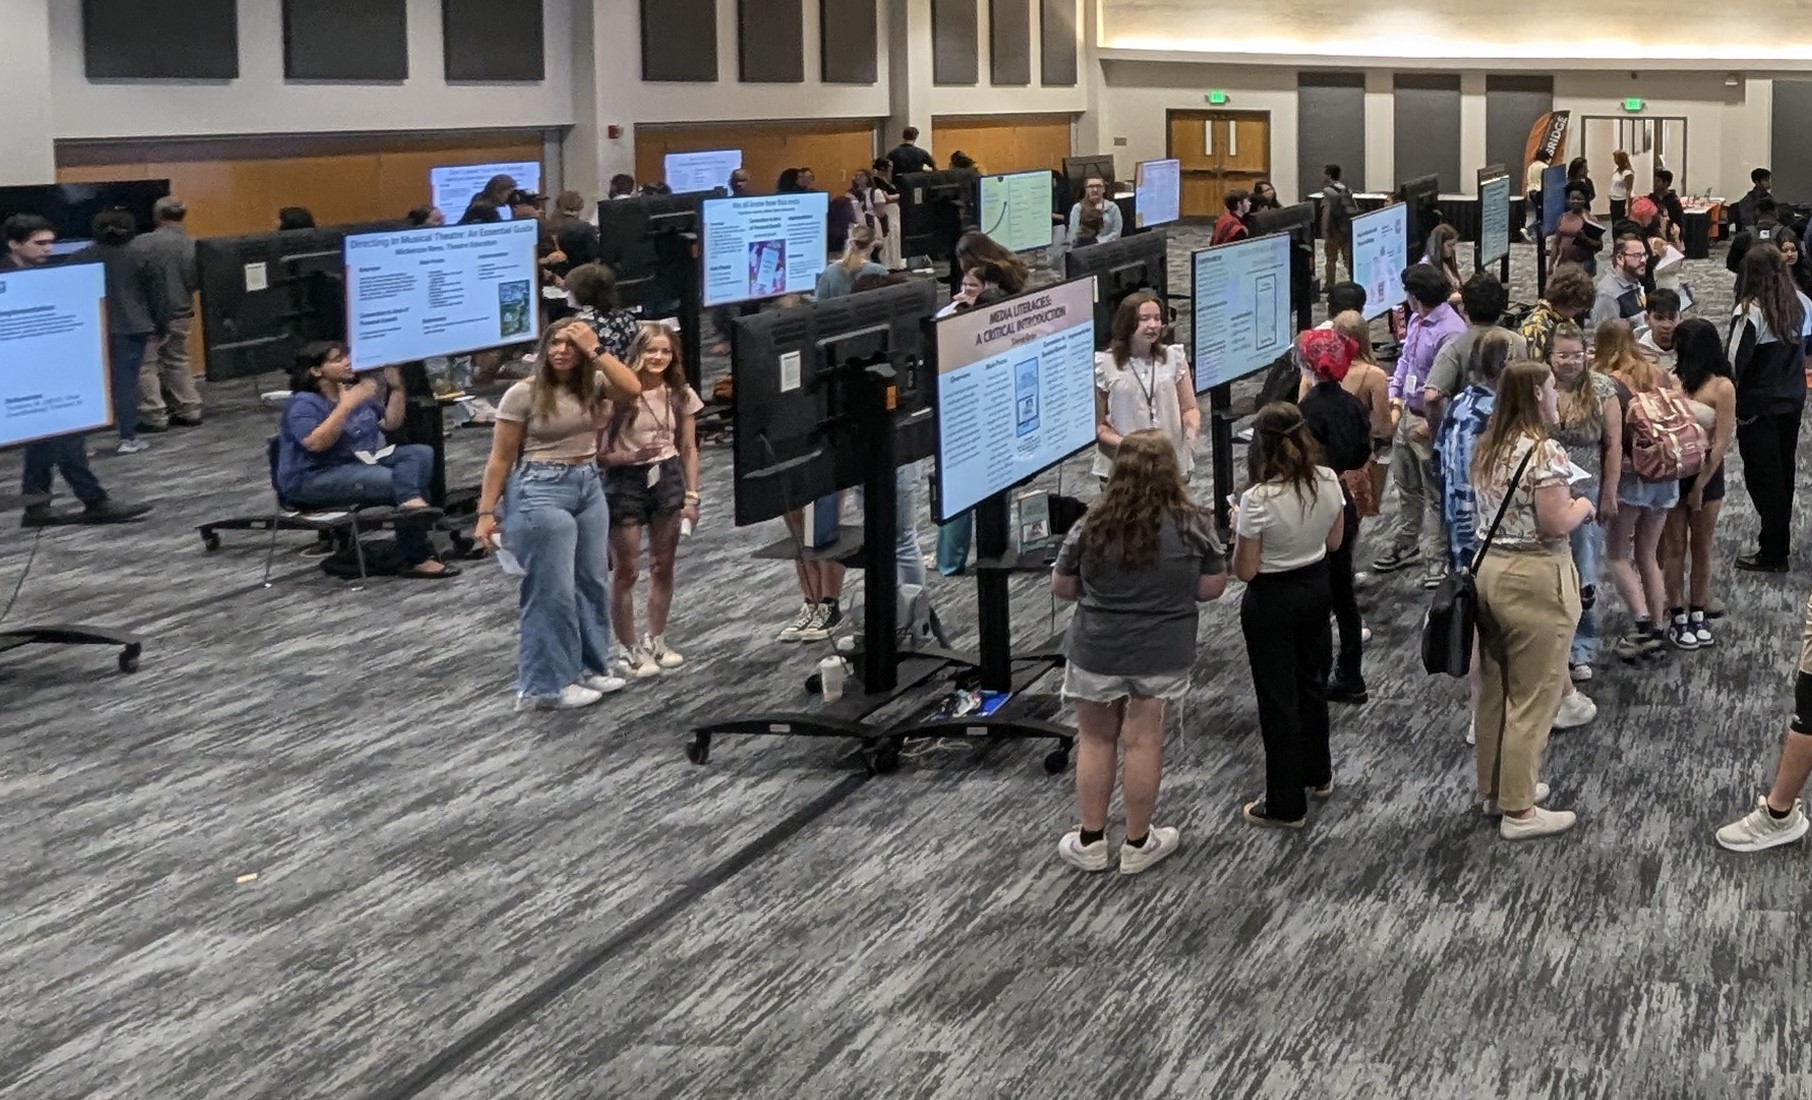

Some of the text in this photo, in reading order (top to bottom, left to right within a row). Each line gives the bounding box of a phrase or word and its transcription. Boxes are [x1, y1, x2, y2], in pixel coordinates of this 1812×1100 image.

[1545, 115, 1568, 157] BRIDGE
[400, 235, 432, 244] Musical
[976, 333, 983, 346] A
[984, 321, 1015, 342] CRITICAL
[1016, 305, 1067, 332] INTRODUCTION
[989, 308, 1013, 325] MEDIA
